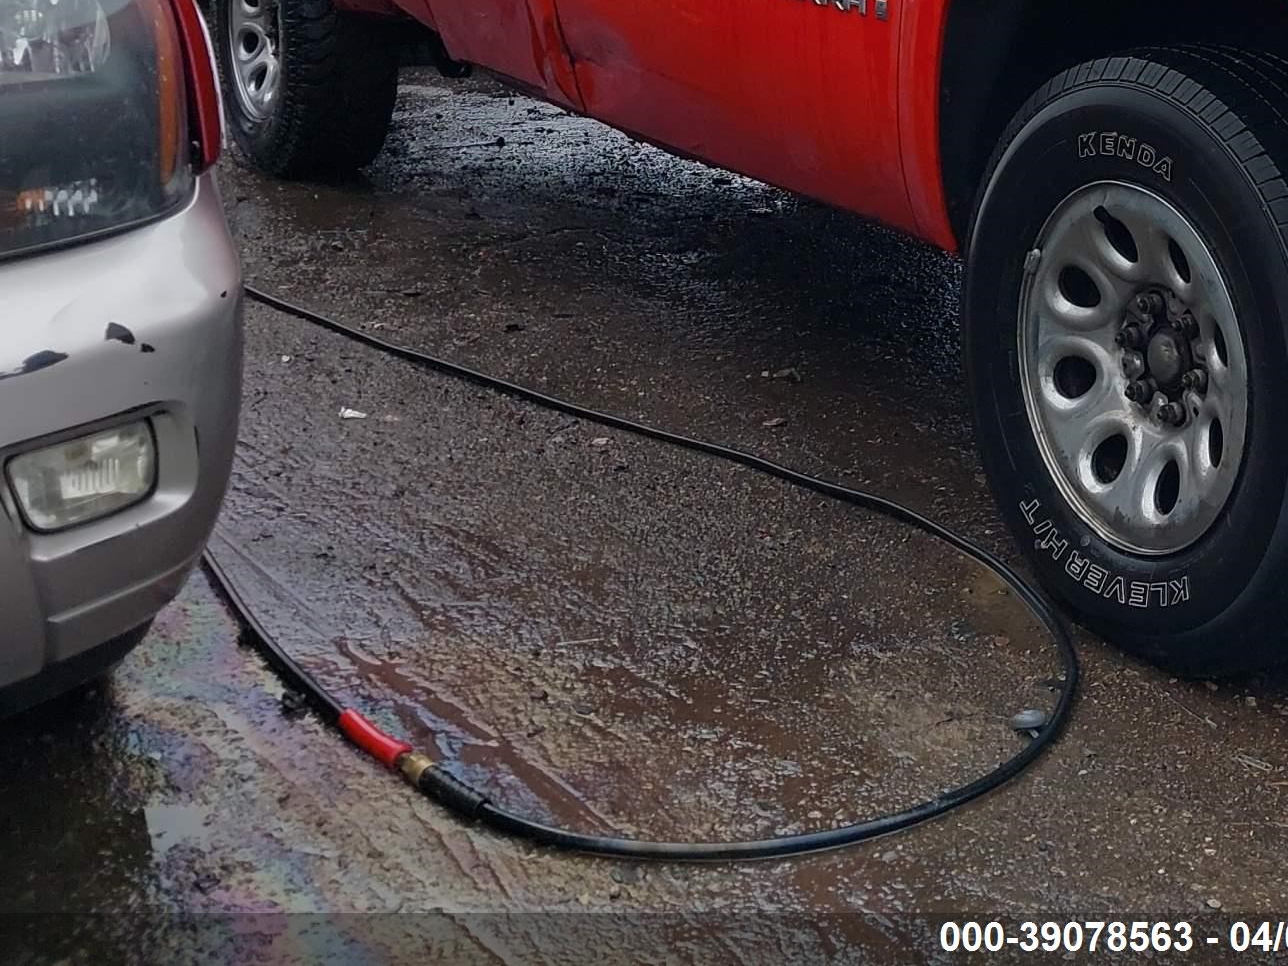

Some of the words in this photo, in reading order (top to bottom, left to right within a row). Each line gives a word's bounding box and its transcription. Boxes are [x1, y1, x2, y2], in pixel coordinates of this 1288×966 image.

[1078, 132, 1173, 182] KENDA
[1019, 498, 1069, 561] H/T
[1064, 550, 1190, 608] KLEVER
